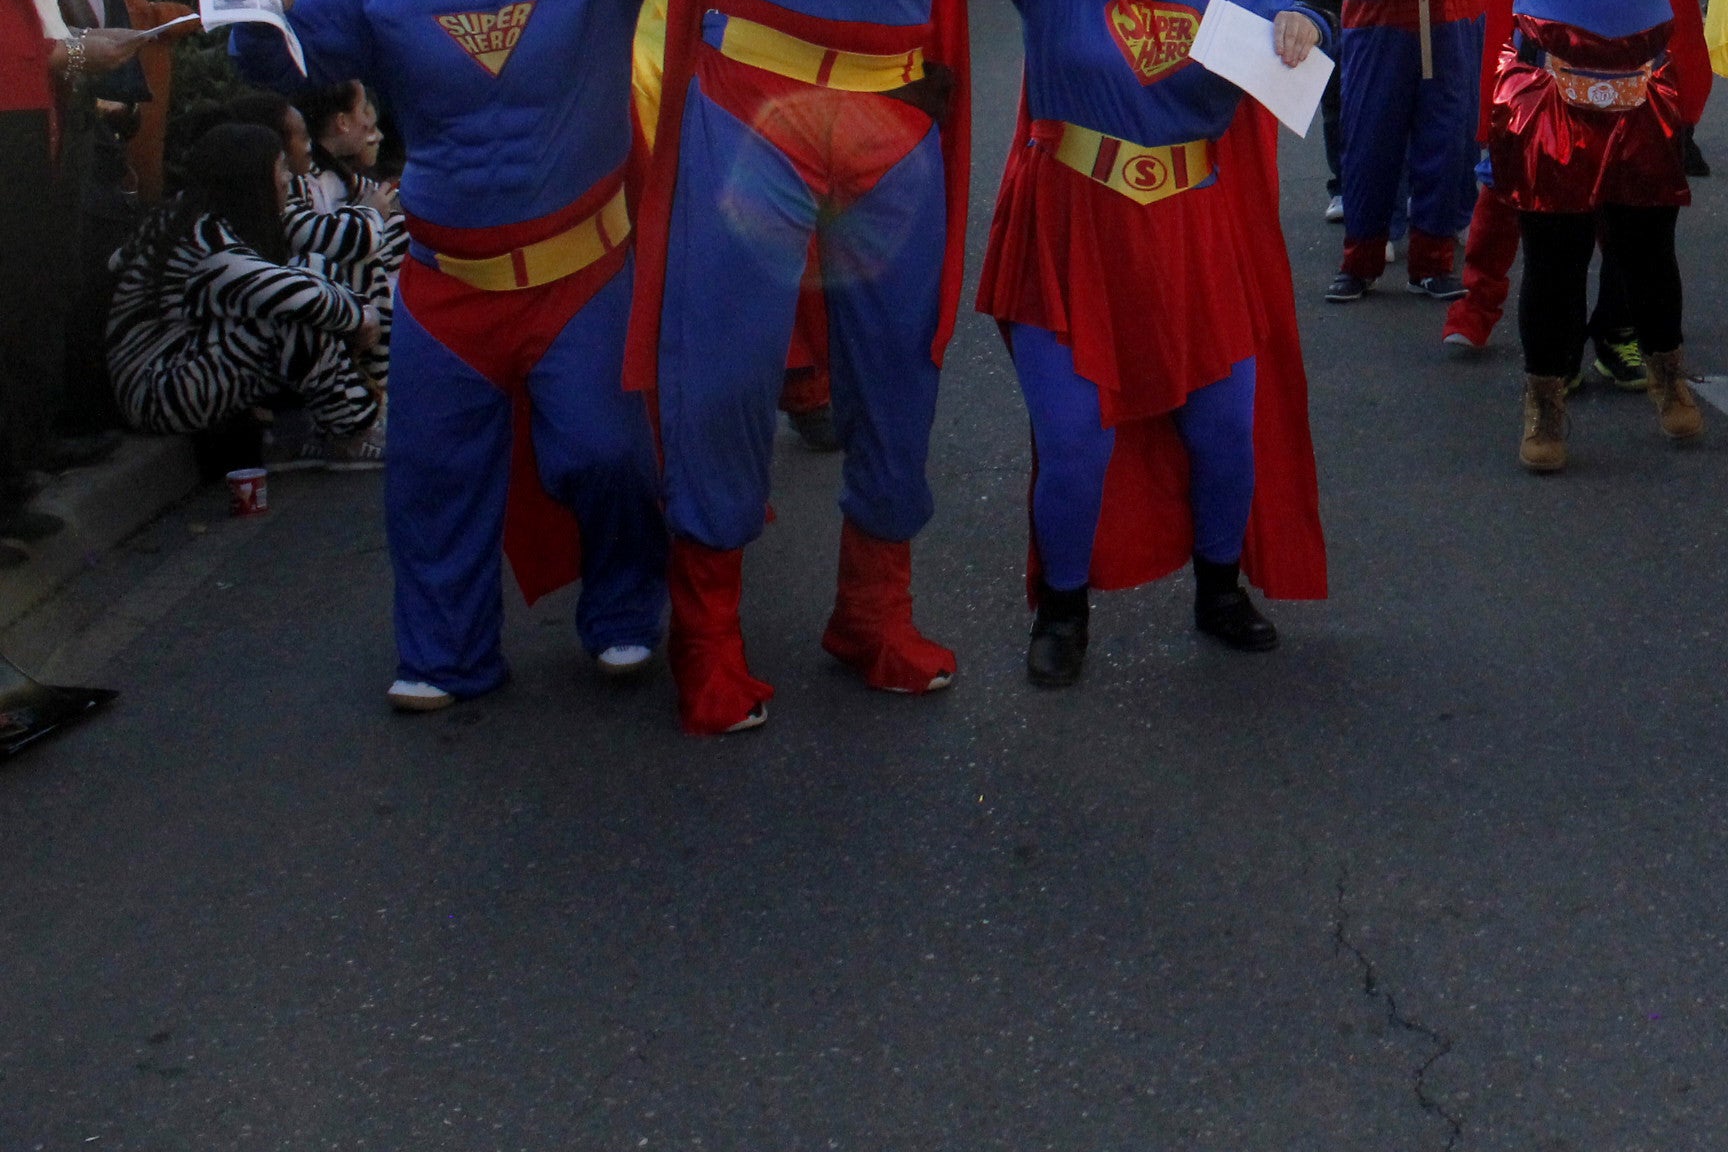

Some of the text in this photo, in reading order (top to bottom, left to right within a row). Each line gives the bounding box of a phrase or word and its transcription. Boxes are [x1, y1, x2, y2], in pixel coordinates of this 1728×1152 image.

[438, 2, 534, 36] SUPER
[1118, 1, 1193, 41] SUPER
[455, 26, 522, 54] HERO
[1135, 41, 1191, 72] HERO
[1134, 159, 1156, 187] S
